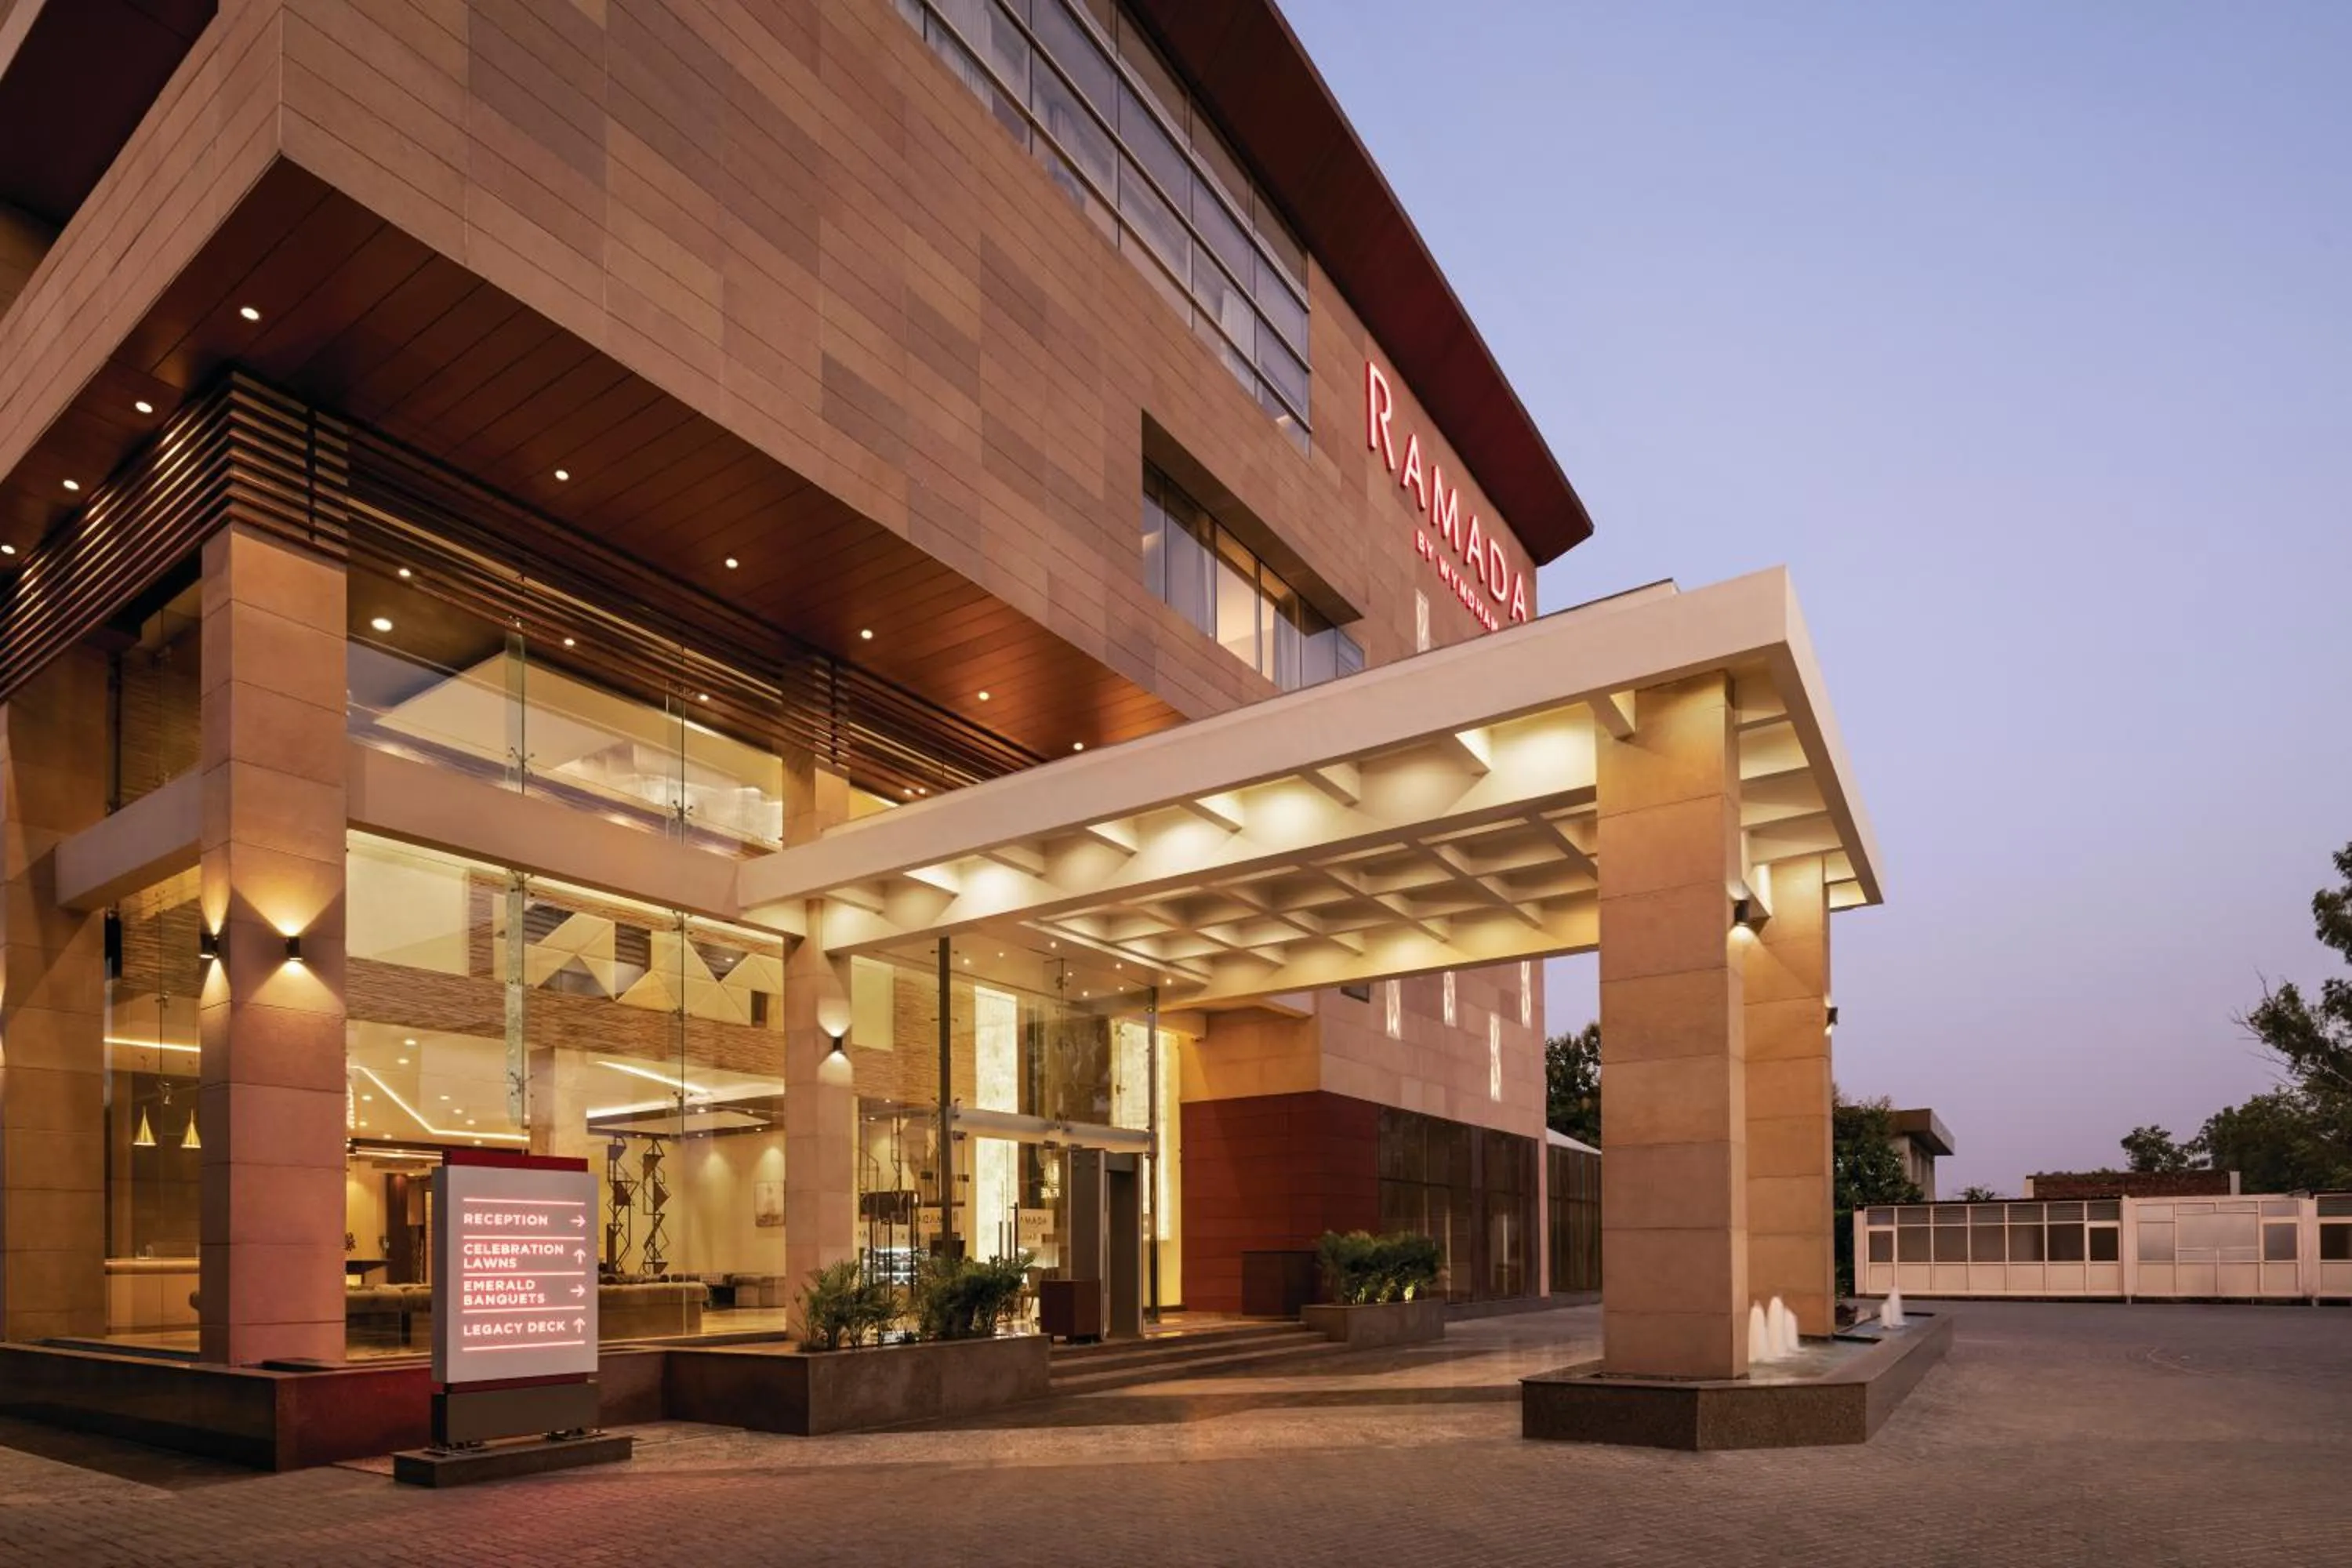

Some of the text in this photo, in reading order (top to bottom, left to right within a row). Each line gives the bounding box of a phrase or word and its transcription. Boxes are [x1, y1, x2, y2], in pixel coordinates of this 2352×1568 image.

[1367, 361, 1527, 623] RAMADA
[1416, 529, 1433, 561] BY
[463, 1214, 548, 1225] RECEPTION
[463, 1243, 564, 1255] CELEBRATION
[463, 1258, 517, 1269] LAWNS
[463, 1279, 535, 1291] EMERALD
[463, 1294, 546, 1305] BANQUETS
[463, 1320, 566, 1336] LEGACY DECK
